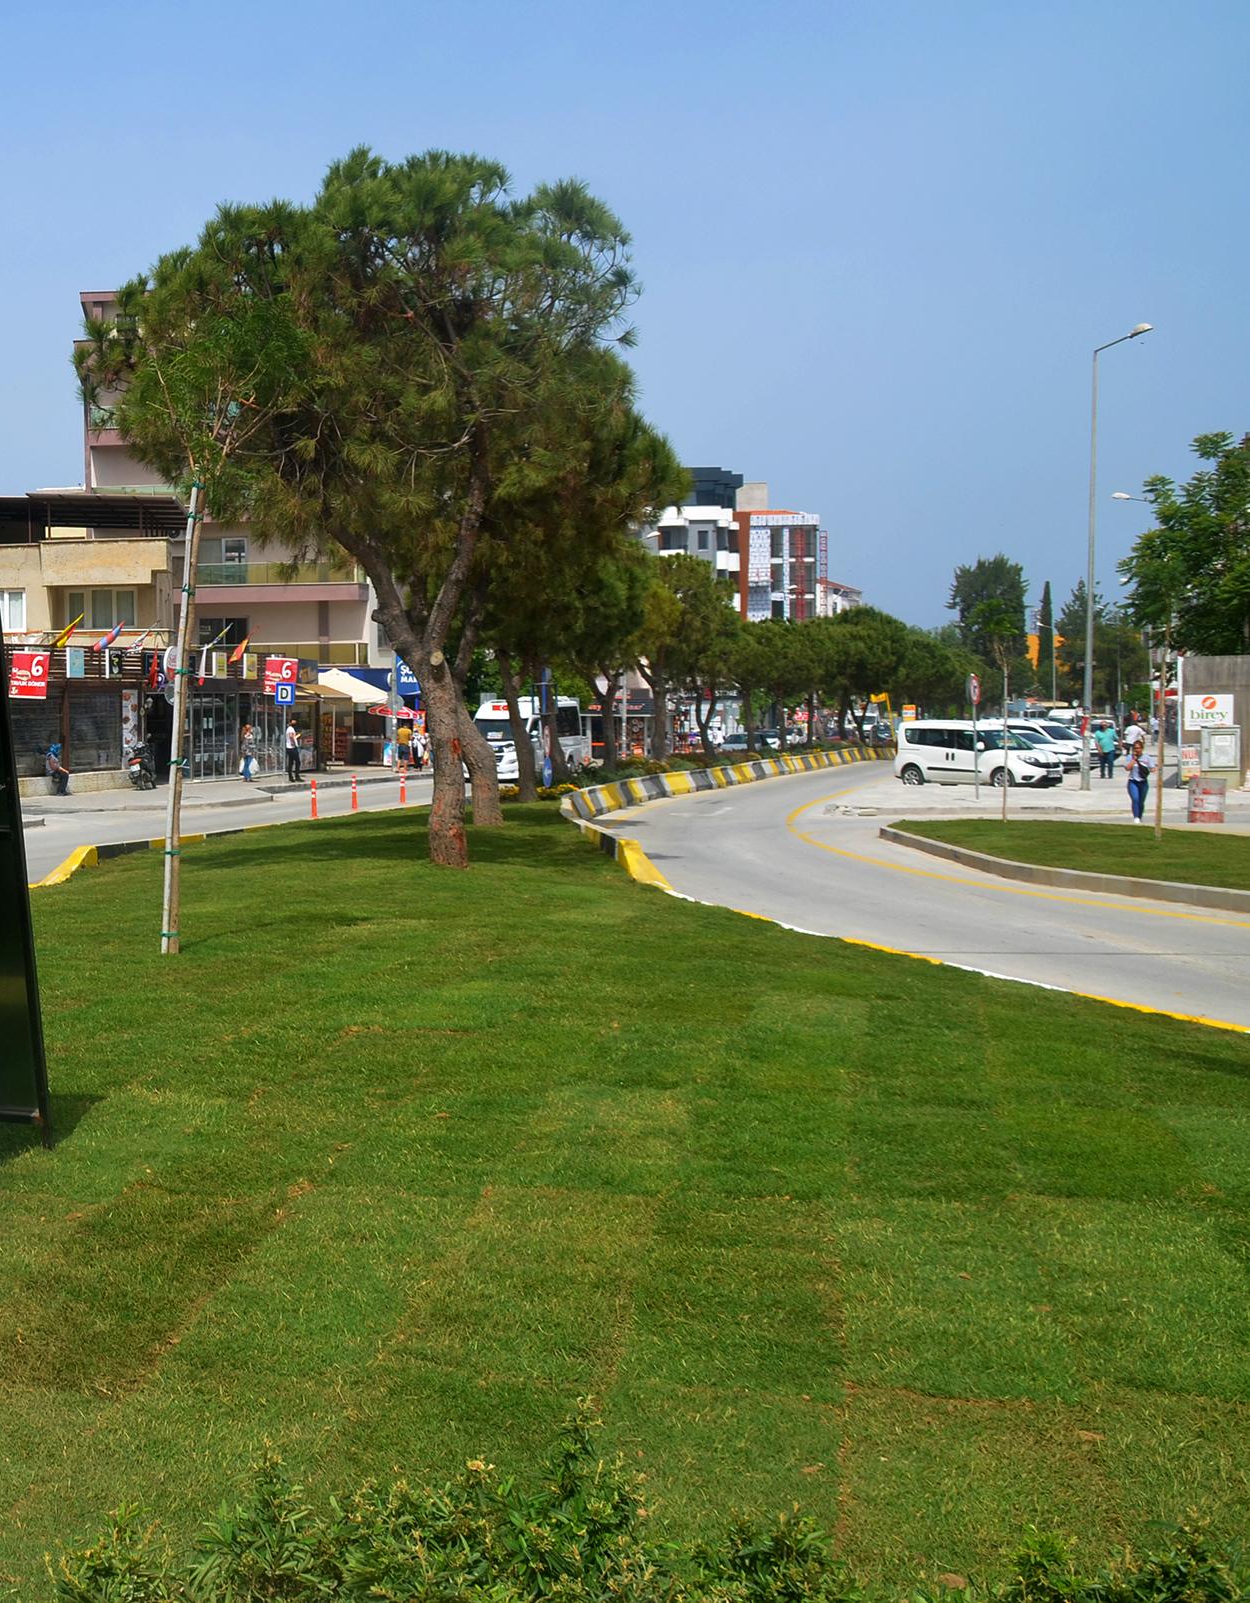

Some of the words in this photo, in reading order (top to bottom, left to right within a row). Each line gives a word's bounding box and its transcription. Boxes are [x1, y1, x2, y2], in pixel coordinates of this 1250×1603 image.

[31, 655, 44, 676] 6
[281, 661, 291, 679] 6
[280, 687, 289, 700] D
